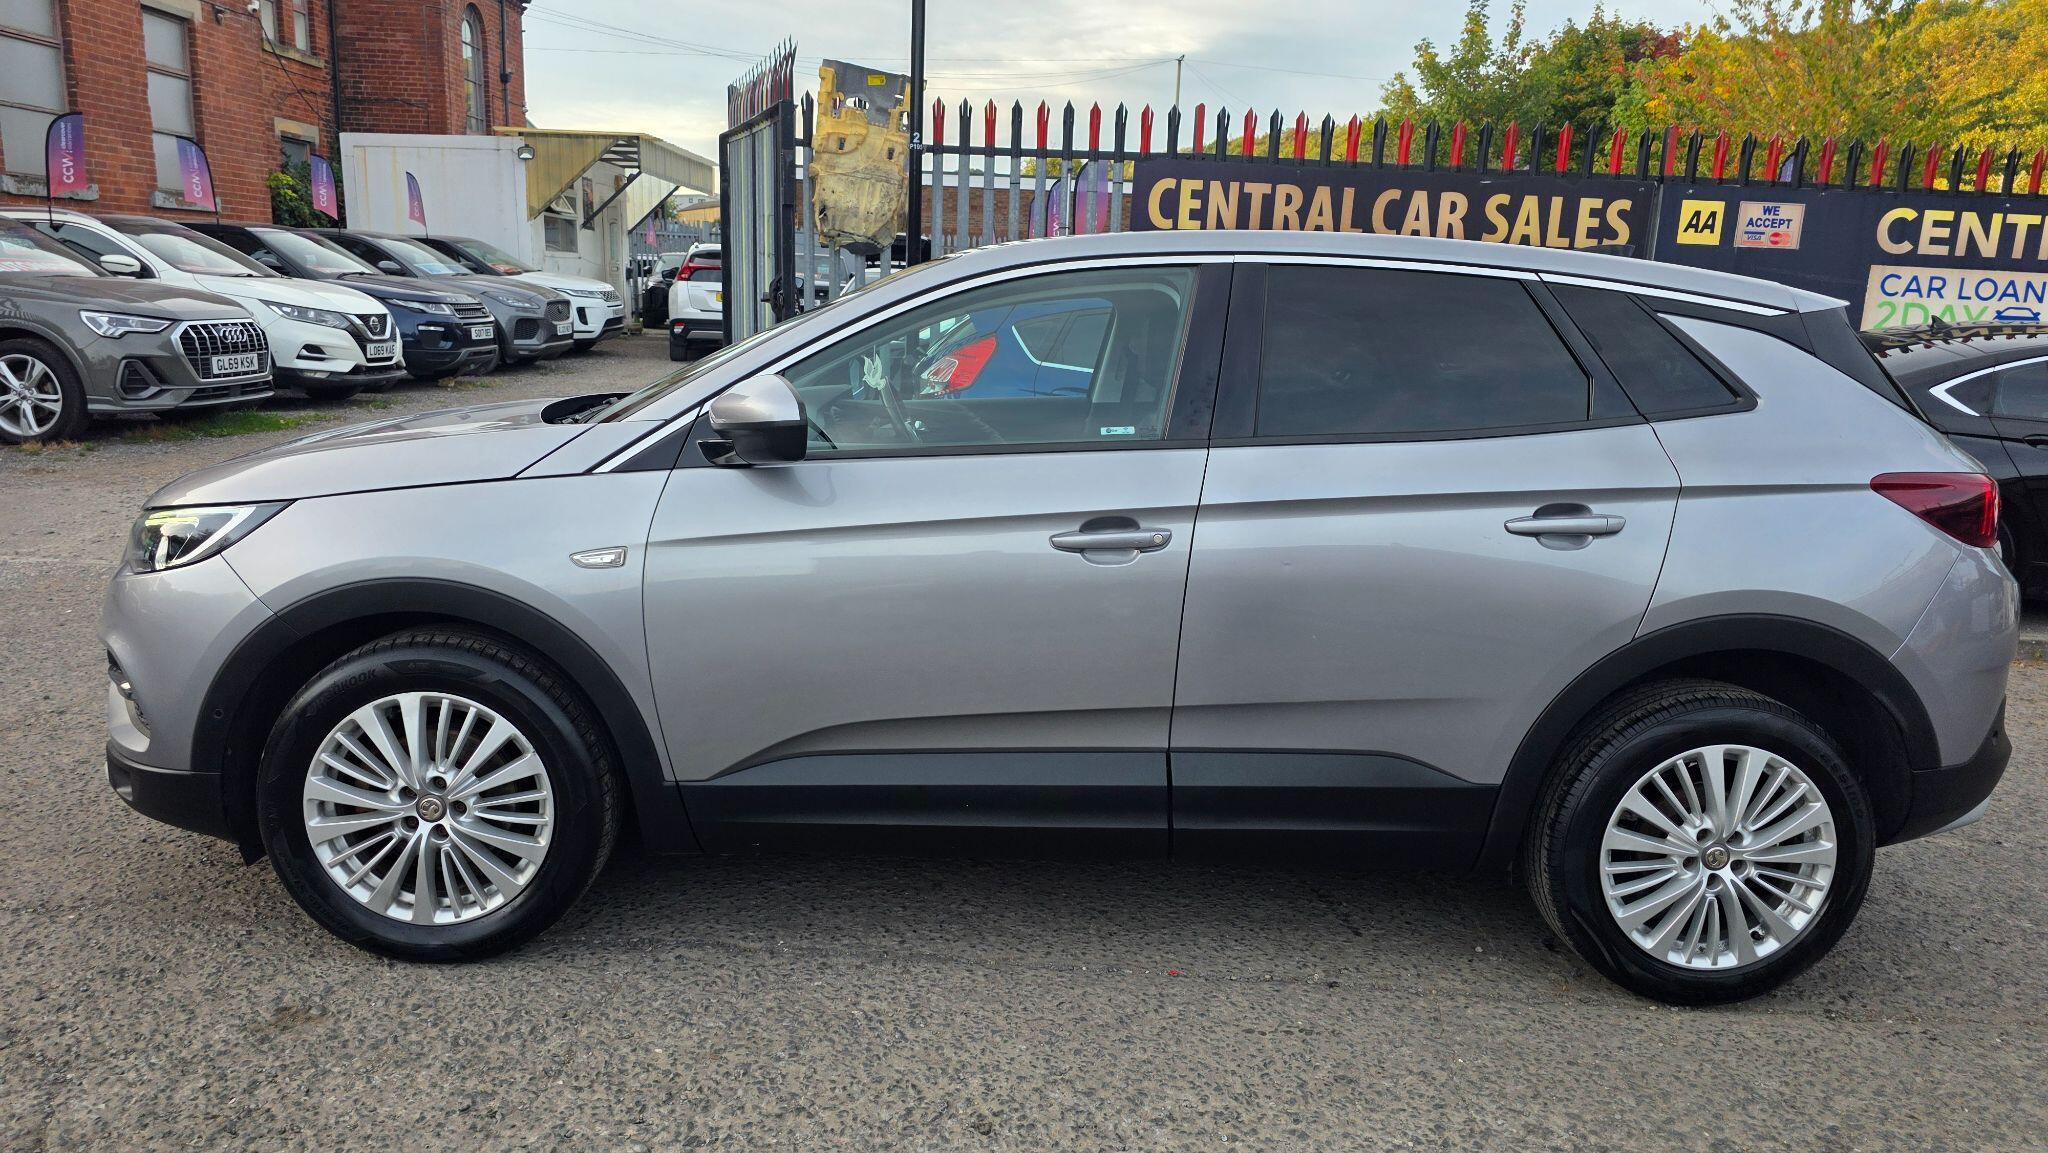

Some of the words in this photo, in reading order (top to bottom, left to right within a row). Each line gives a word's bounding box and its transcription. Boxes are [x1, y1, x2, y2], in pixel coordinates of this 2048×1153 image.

[912, 132, 920, 143] 2
[62, 152, 74, 183] CCW
[1148, 178, 1363, 232] CENTRAL
[1372, 189, 1468, 240] CAR
[1482, 194, 1633, 248] SALES
[1763, 205, 1780, 216] WE
[1683, 210, 1717, 234] AA
[1746, 217, 1793, 229] ACCEPT
[1880, 273, 1947, 298] CAR
[217, 358, 239, 371] GL69
[240, 355, 256, 369] KSK
